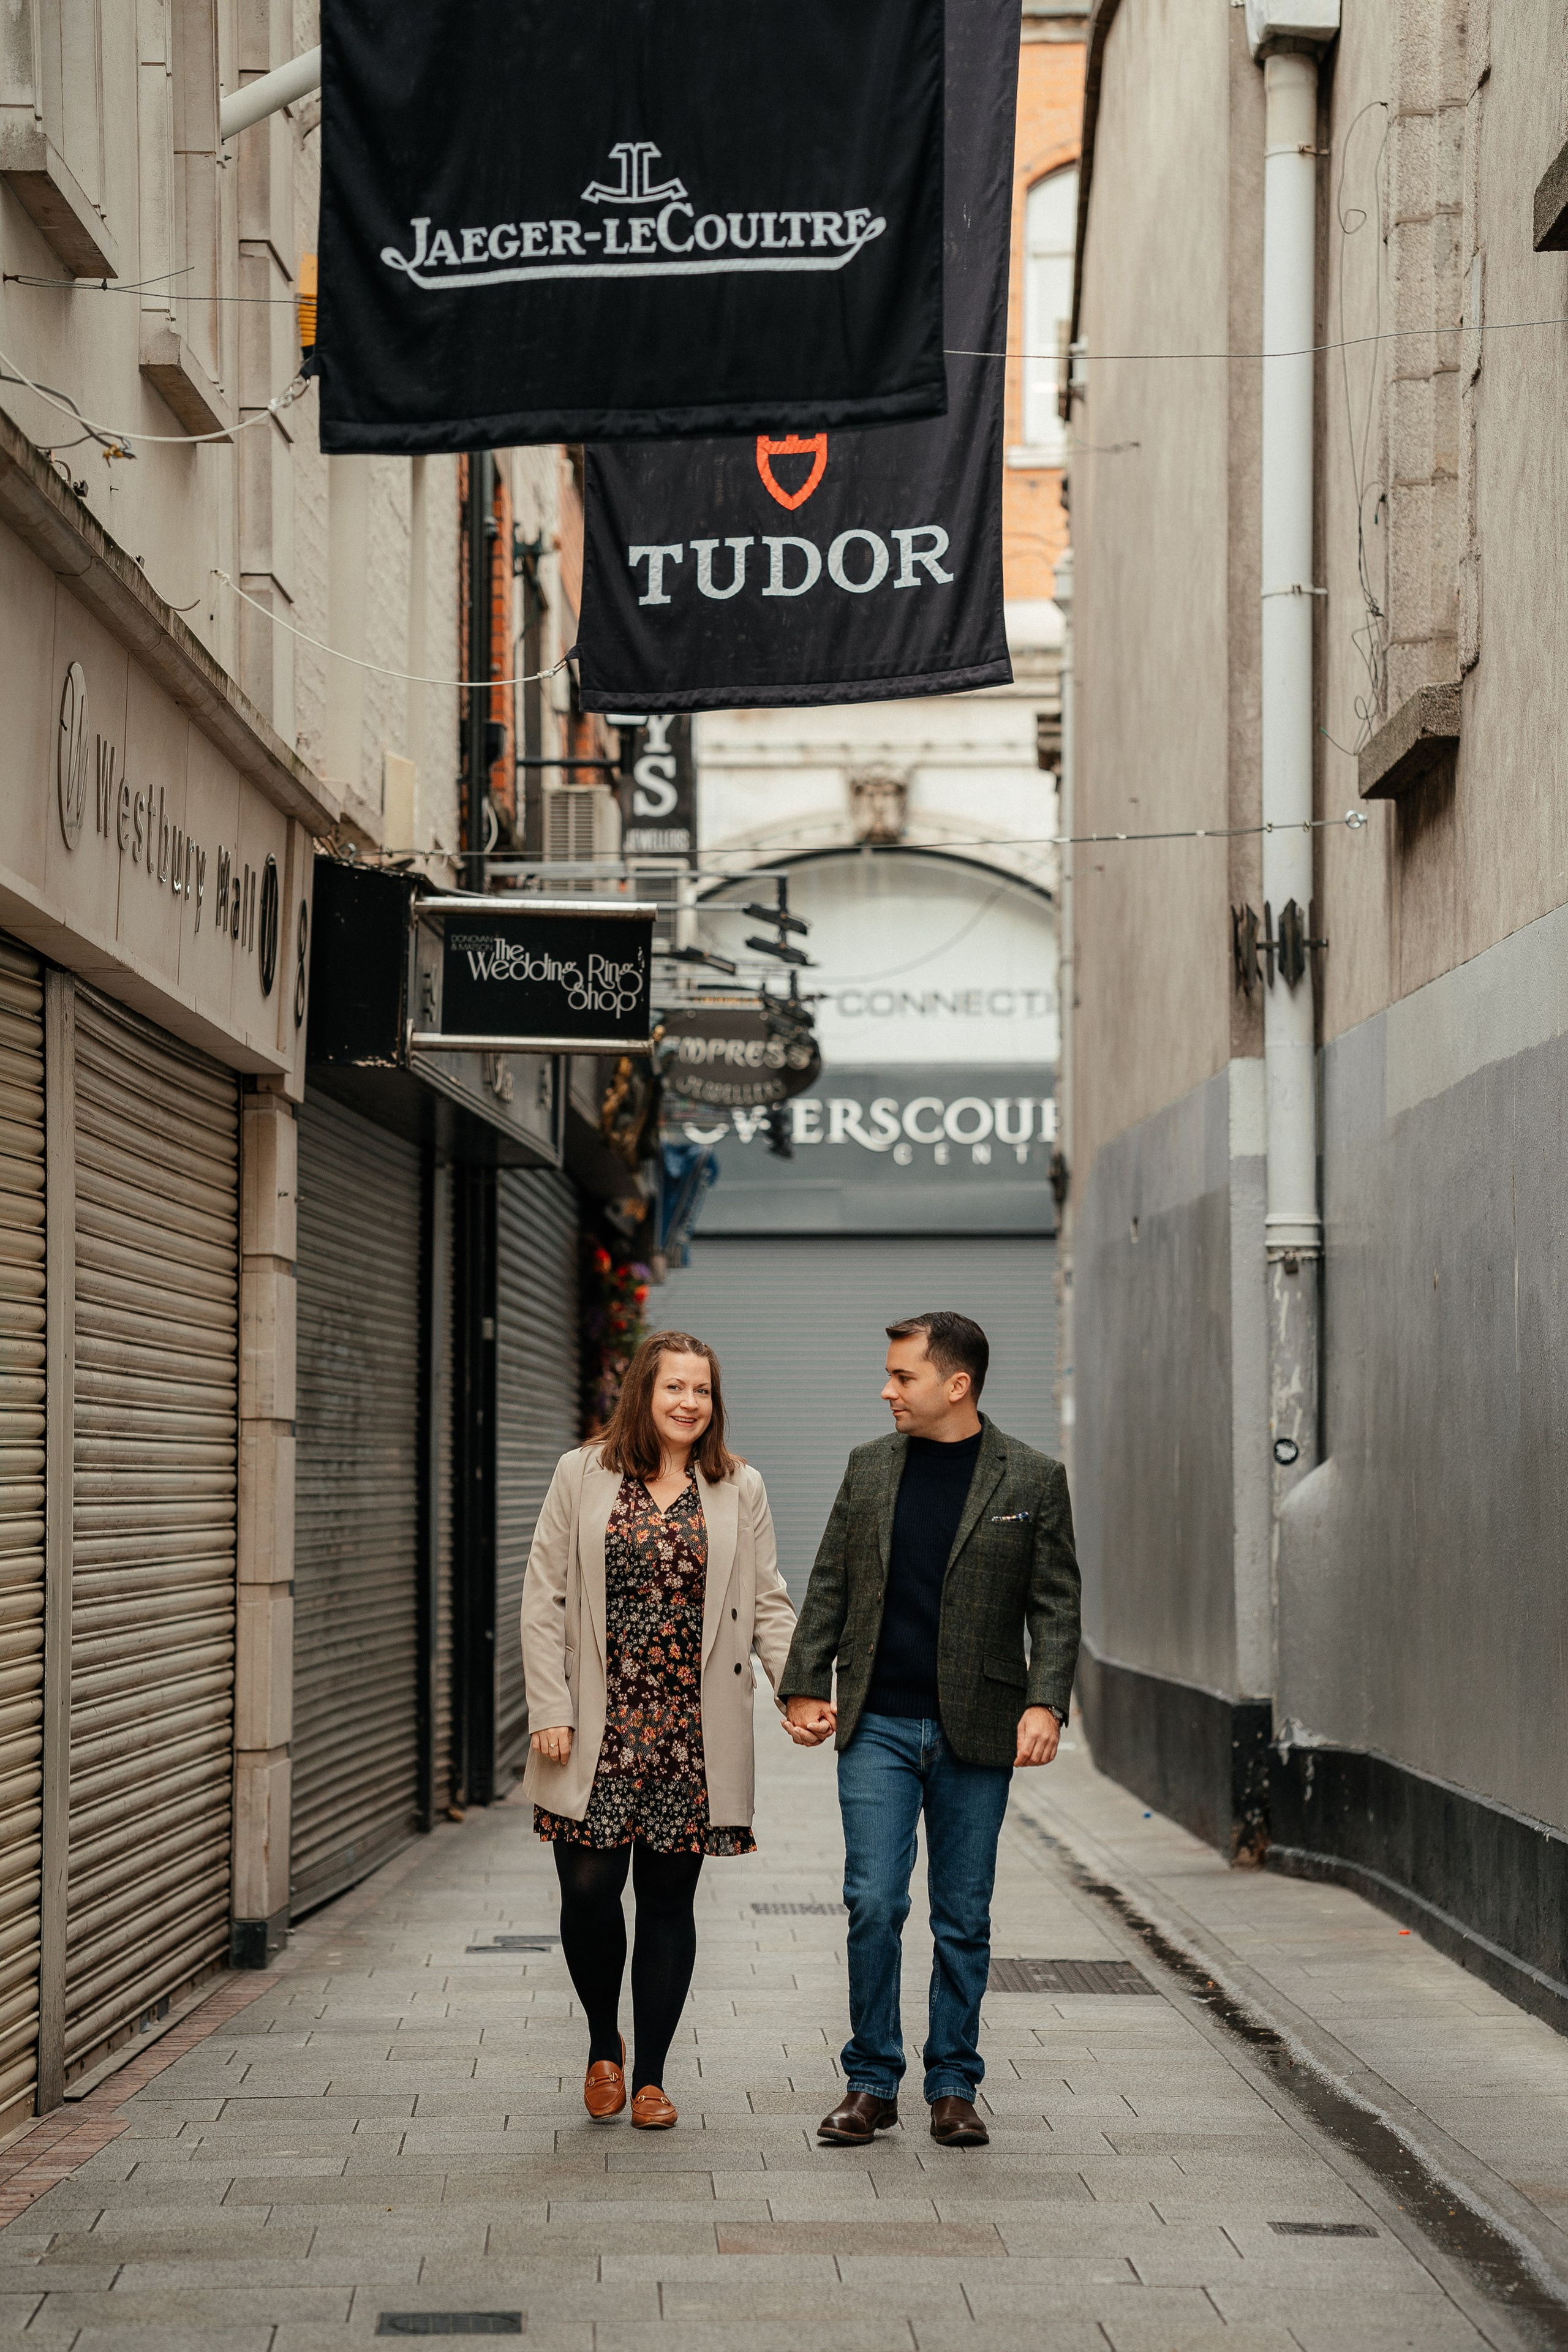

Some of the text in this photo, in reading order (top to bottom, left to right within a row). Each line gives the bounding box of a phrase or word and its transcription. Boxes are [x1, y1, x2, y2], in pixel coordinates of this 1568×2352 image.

[628, 524, 954, 606] TUDOR
[96, 734, 256, 953] Westbury Mall
[494, 938, 524, 960] The
[467, 950, 643, 996] Wedding Ring
[568, 981, 636, 1019] Shop
